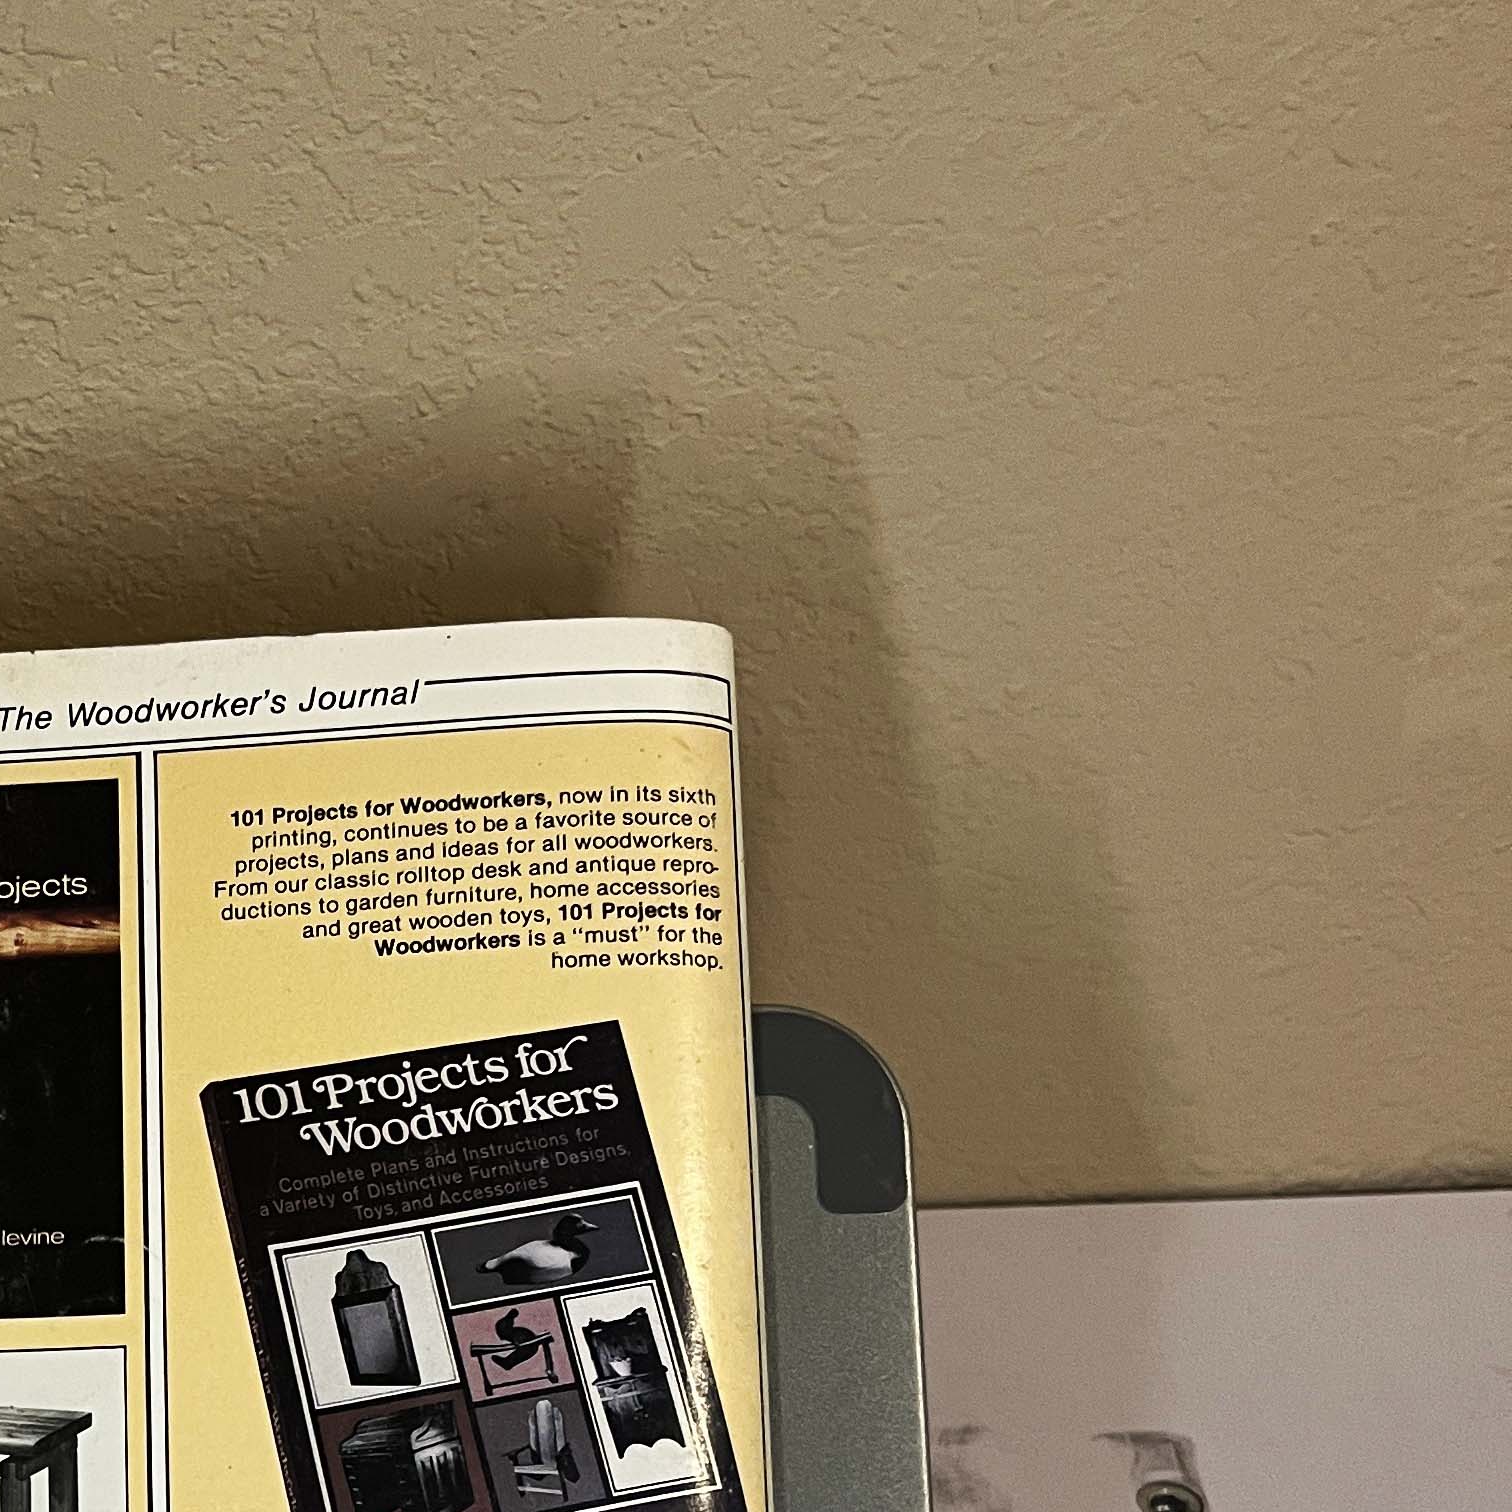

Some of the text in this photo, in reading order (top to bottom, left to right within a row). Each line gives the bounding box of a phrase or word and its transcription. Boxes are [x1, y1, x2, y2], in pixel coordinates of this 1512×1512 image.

[69, 689, 286, 728] Woodworker's
[299, 679, 420, 712] Journal
[231, 785, 716, 827] 101 Projects for Woodworkers, now in its sixth
[252, 810, 717, 853] printing, continues to be a favorite source of
[221, 880, 720, 921] ductions to garden furniture, home accessories
[374, 932, 520, 956] Woodworkers
[529, 929, 546, 946] is
[553, 932, 566, 945] a
[657, 925, 686, 942] for
[692, 927, 722, 946] the
[552, 949, 723, 972] home workshop.
[233, 1035, 587, 1123] 101 Projects for
[299, 1083, 619, 1156] Woodworkers
[278, 1126, 600, 1193] Complete Plans and Instructions for
[259, 1204, 269, 1217] a
[272, 1193, 336, 1215] Variety
[343, 1187, 359, 1202] of
[368, 1172, 464, 1197] Distinctive
[469, 1157, 550, 1182] Furniture
[401, 1197, 434, 1212] and
[439, 1176, 549, 1207] Accessories
[2, 1228, 64, 1246] levine
